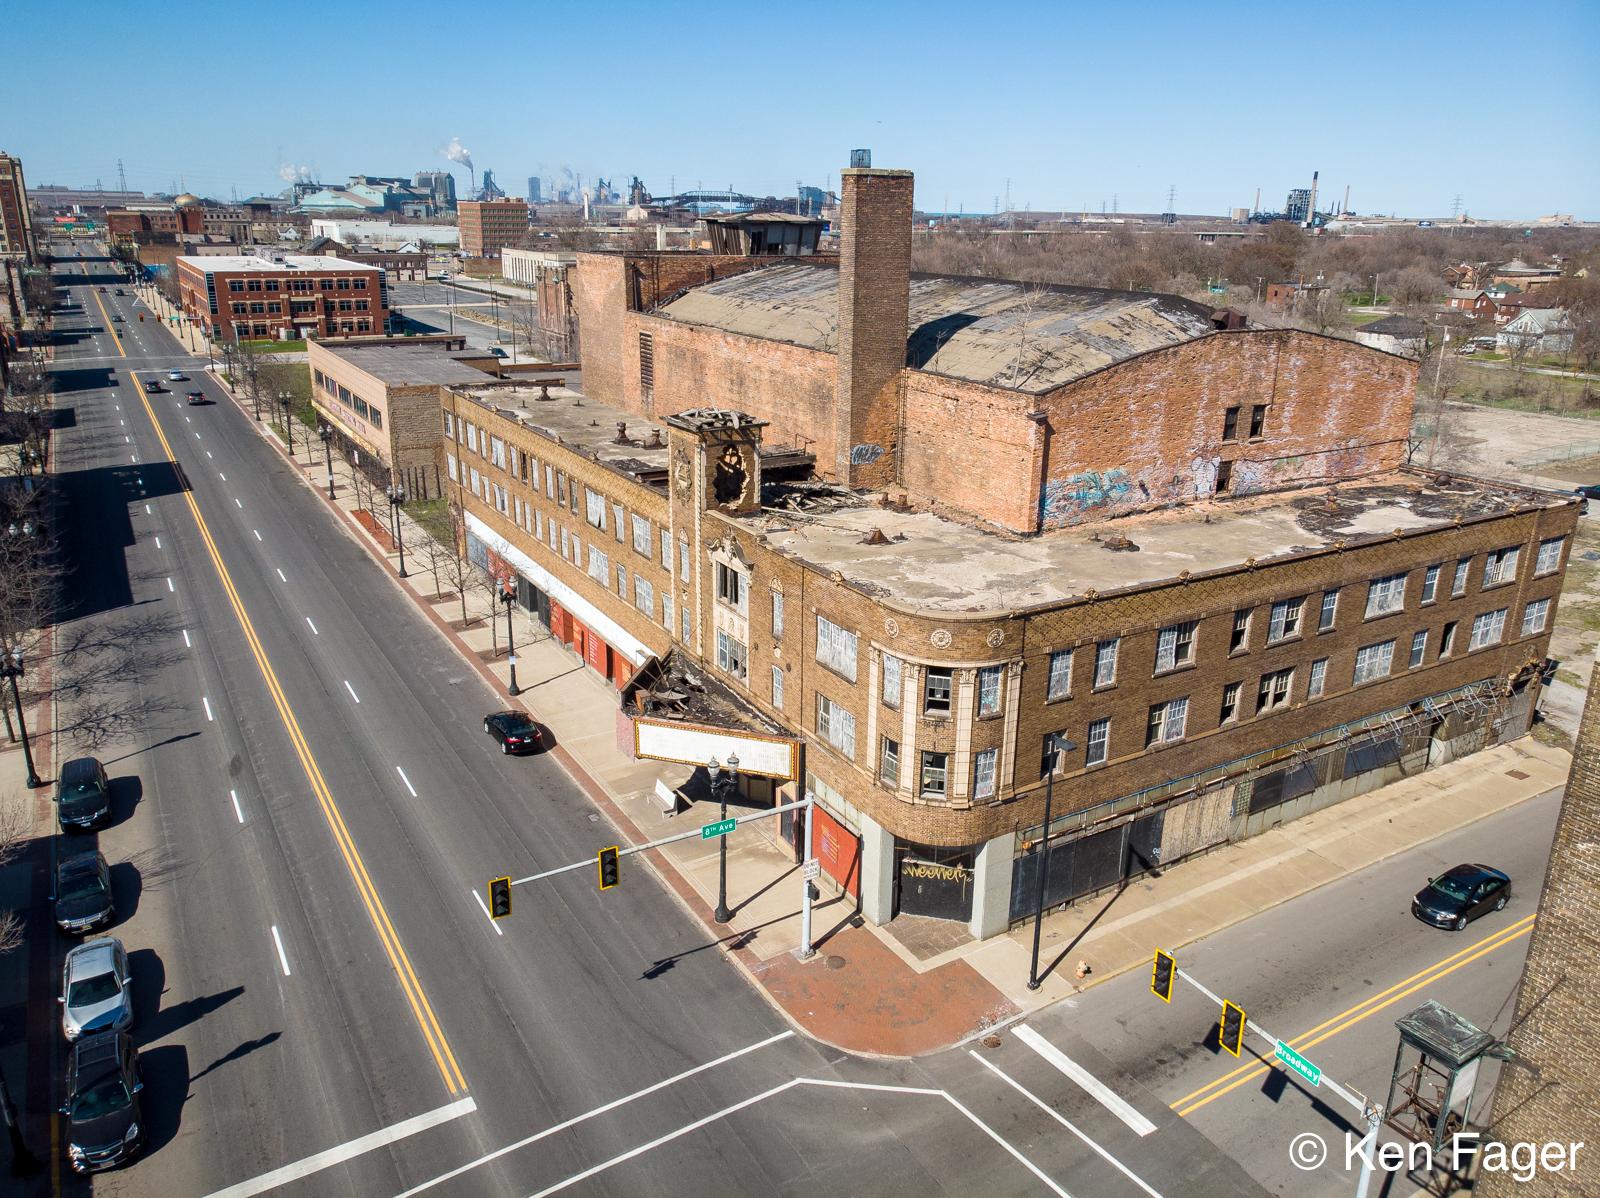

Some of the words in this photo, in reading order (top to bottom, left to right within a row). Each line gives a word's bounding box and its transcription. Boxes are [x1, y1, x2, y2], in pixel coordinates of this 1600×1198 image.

[705, 827, 716, 836] 8TH
[719, 823, 733, 832] Ave
[1277, 1044, 1319, 1082] Broadway
